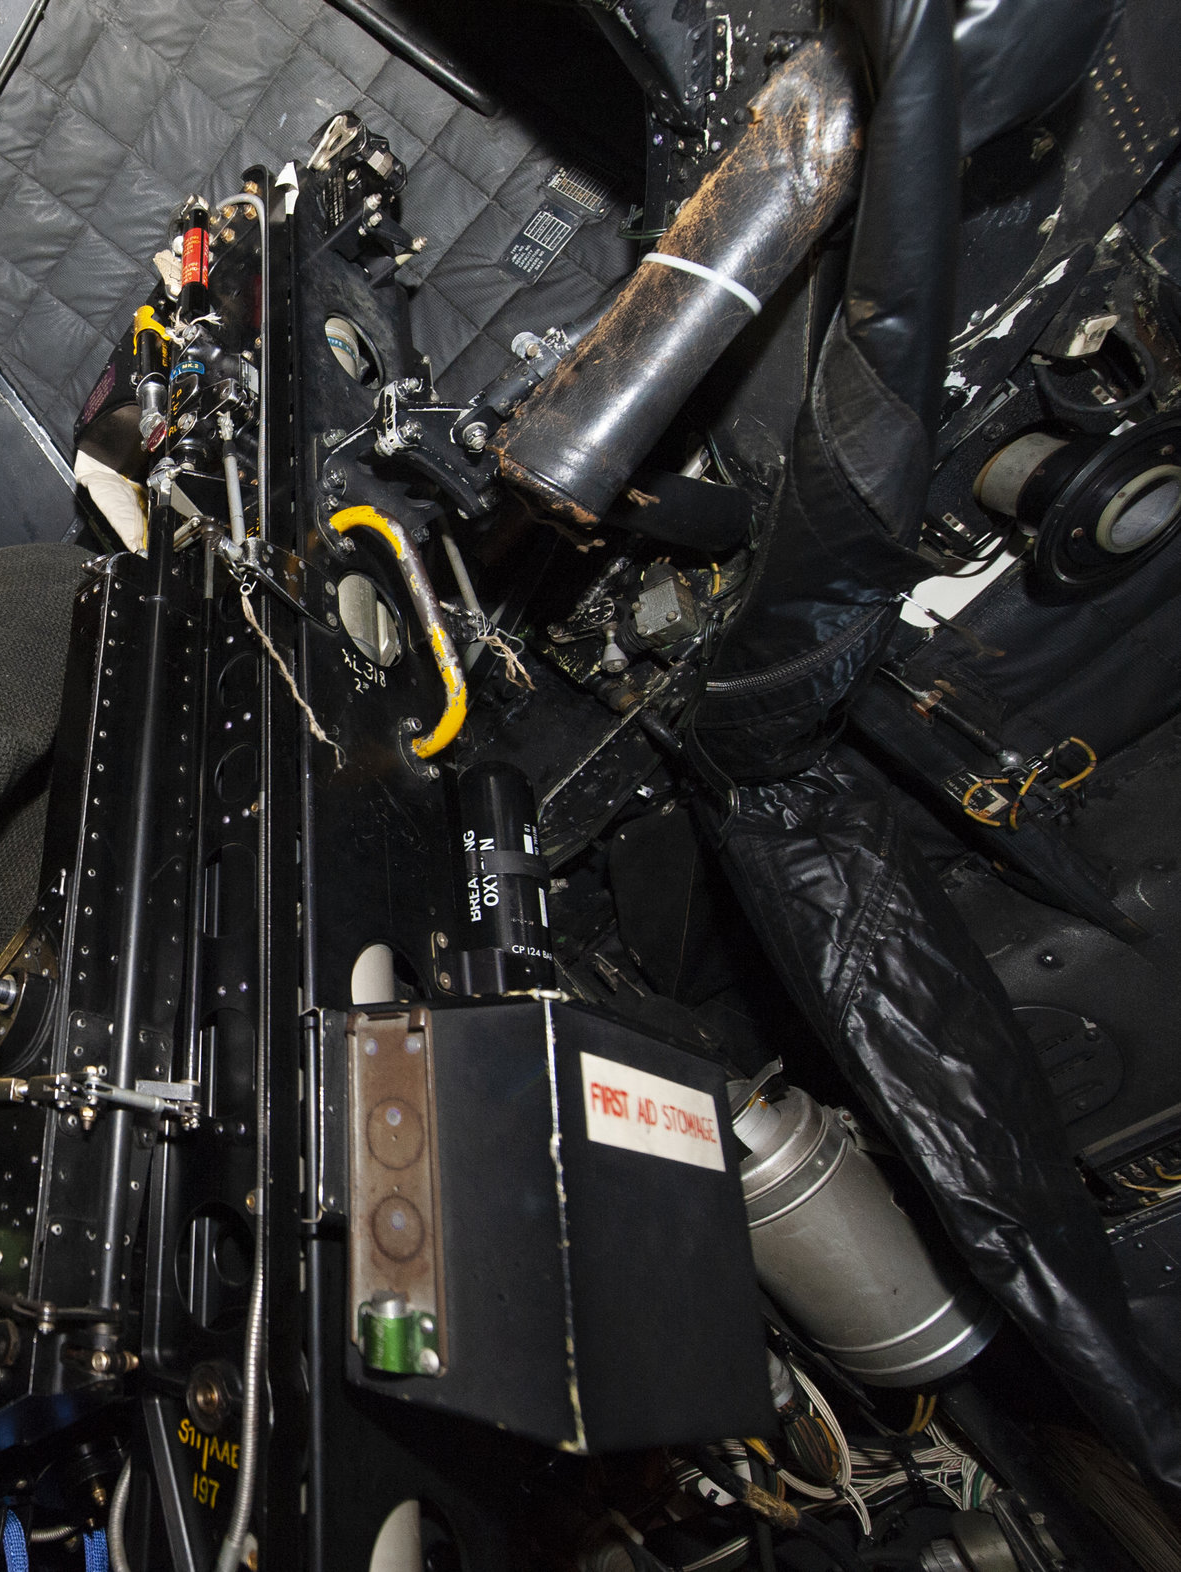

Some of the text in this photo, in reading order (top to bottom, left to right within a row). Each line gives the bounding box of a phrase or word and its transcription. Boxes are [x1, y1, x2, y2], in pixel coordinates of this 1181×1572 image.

[518, 249, 534, 268] CAPACITY
[512, 944, 526, 954] CP
[527, 946, 541, 957] 124
[591, 1082, 717, 1144] FIRST AID STOWAGE
[192, 1472, 220, 1510] 197
